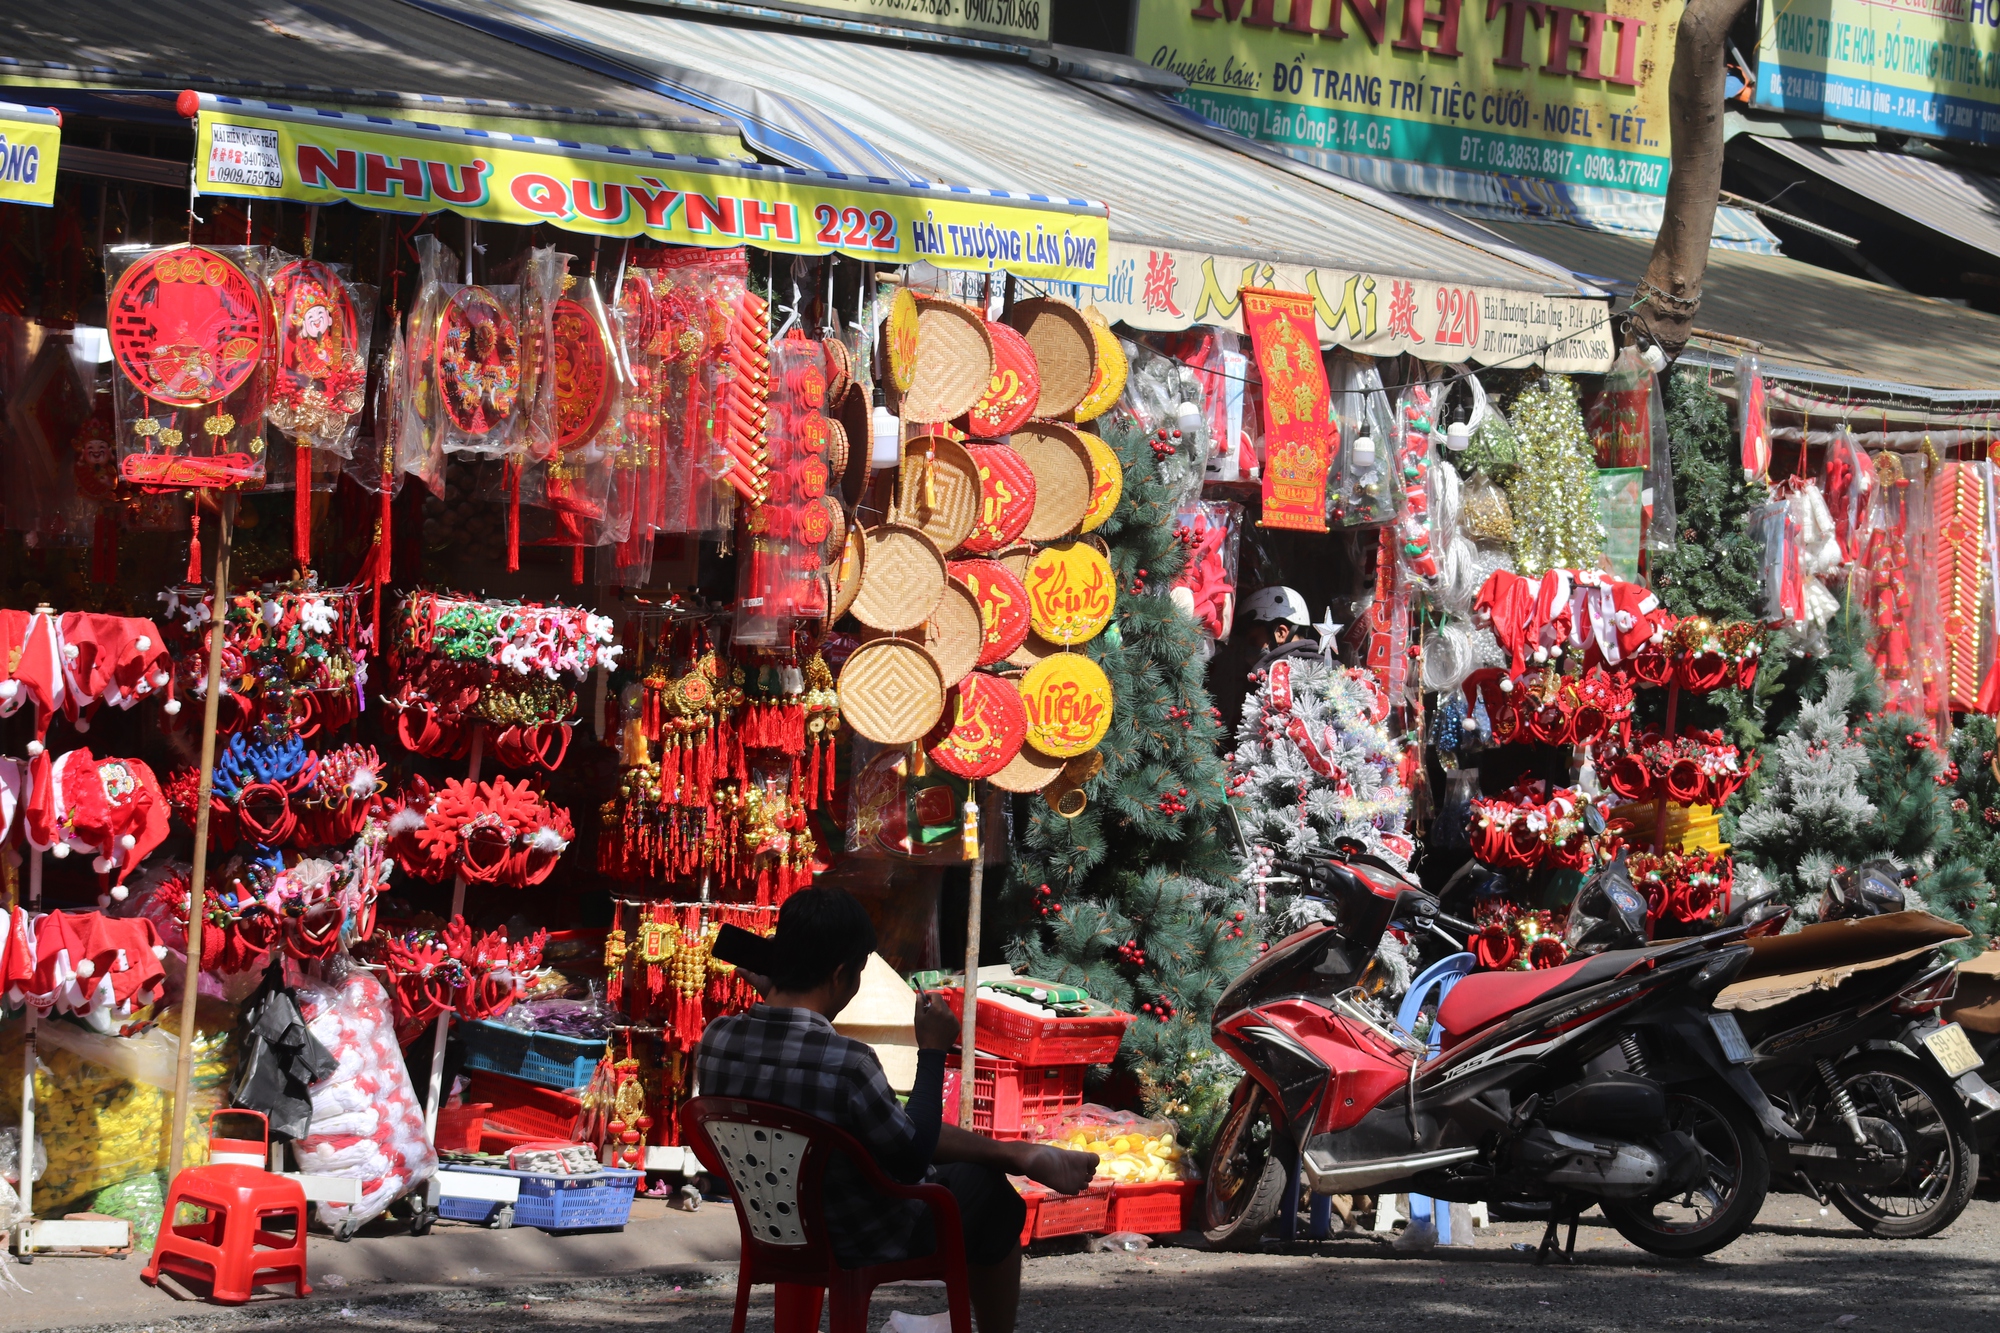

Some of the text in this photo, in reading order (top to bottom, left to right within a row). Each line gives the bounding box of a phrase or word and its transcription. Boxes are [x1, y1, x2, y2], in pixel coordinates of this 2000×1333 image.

[1776, 11, 1813, 53] TRANG
[1817, 10, 1834, 58] TRÍ
[1834, 22, 1850, 61] XE
[1852, 26, 1875, 66] HOA
[1903, 36, 1938, 78] TRANG
[1273, 53, 1304, 95] ĐỒ
[1312, 68, 1382, 107] TRANG
[1389, 75, 1424, 113] TRÍ
[1430, 81, 1475, 124] TIỆC
[1482, 89, 1530, 129] CƯỚI
[1543, 103, 1593, 138] NOEL
[1873, 88, 1891, 114] ÔNG
[1262, 105, 1292, 137] Lãn
[1295, 106, 1326, 148] Ông
[217, 166, 281, 187] 0909.759784
[1488, 140, 1574, 176] 08.3853.8317
[1584, 154, 1662, 188] 0903.377847
[297, 144, 1097, 270] NHƯ QUỲNH 222 HẢI THƯỢNG LÃN ÔNG
[1434, 286, 1480, 348] 220
